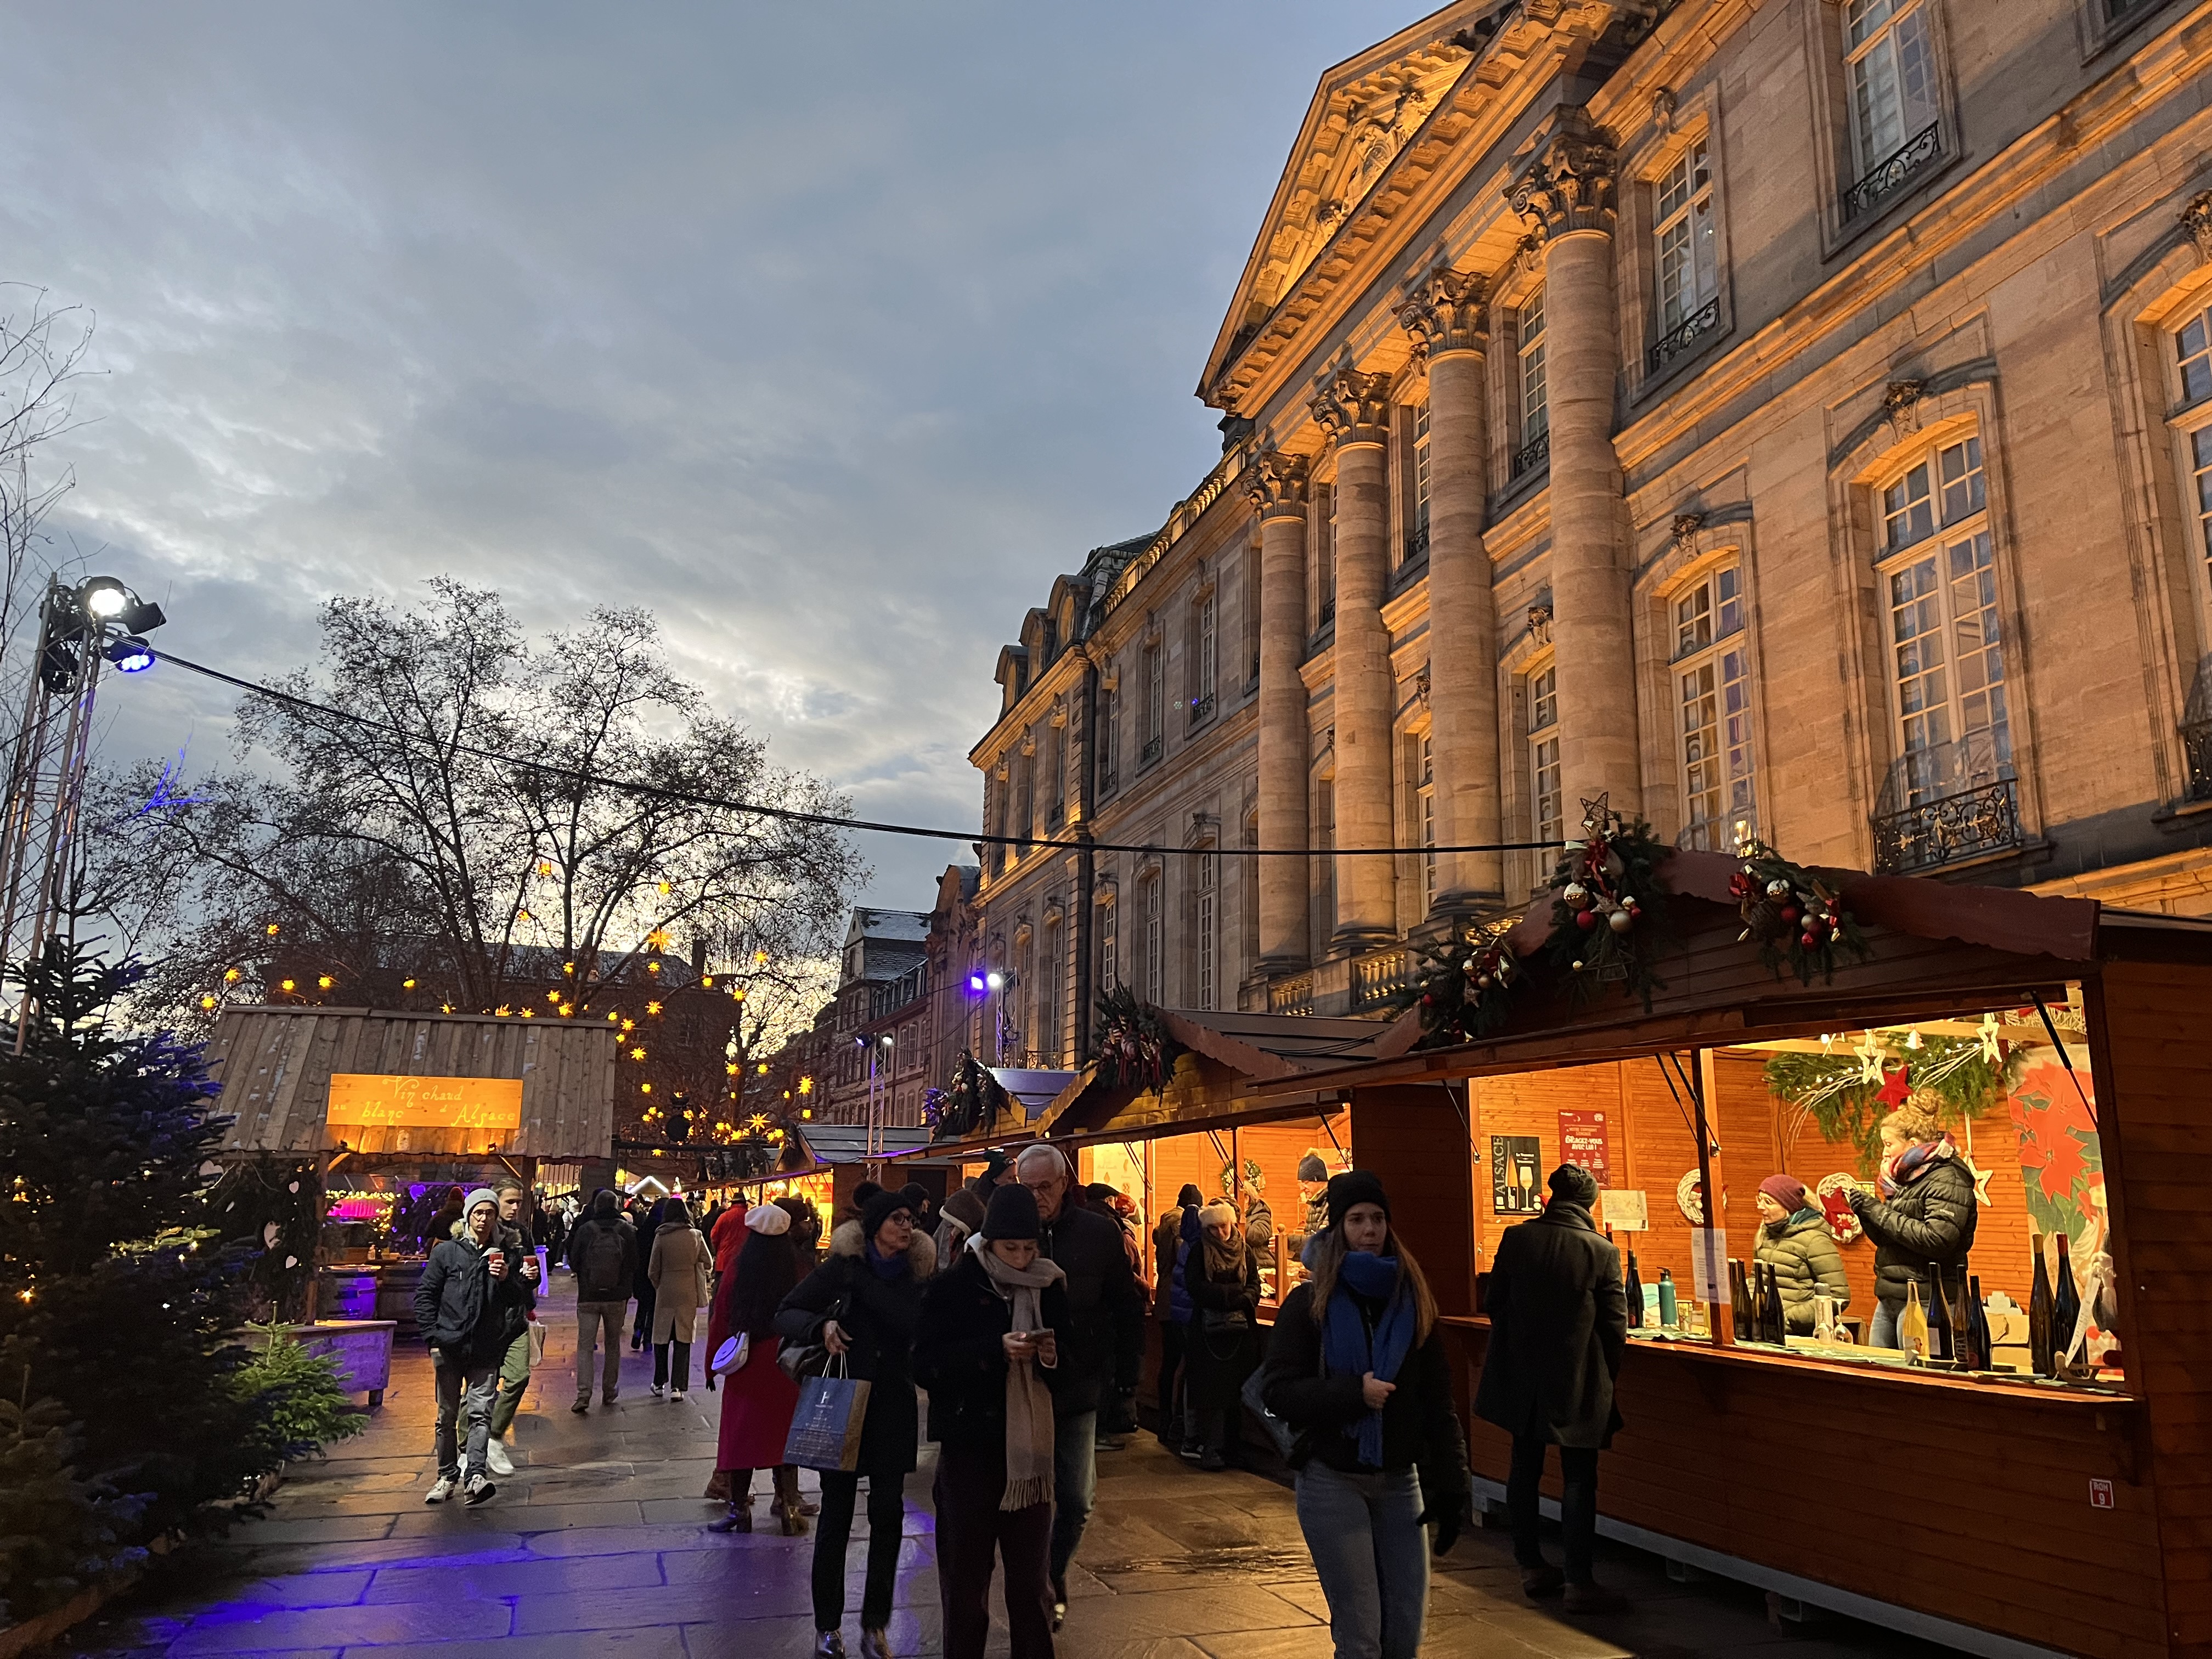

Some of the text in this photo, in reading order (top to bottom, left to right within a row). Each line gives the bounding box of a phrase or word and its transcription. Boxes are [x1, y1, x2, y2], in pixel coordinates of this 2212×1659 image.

[382, 1076, 464, 1108] Vin chaud
[362, 1101, 404, 1125] blanc
[450, 1103, 516, 1127] Alsace
[1493, 1137, 1505, 1195] ALSACE
[2099, 1493, 2106, 1505] 9
